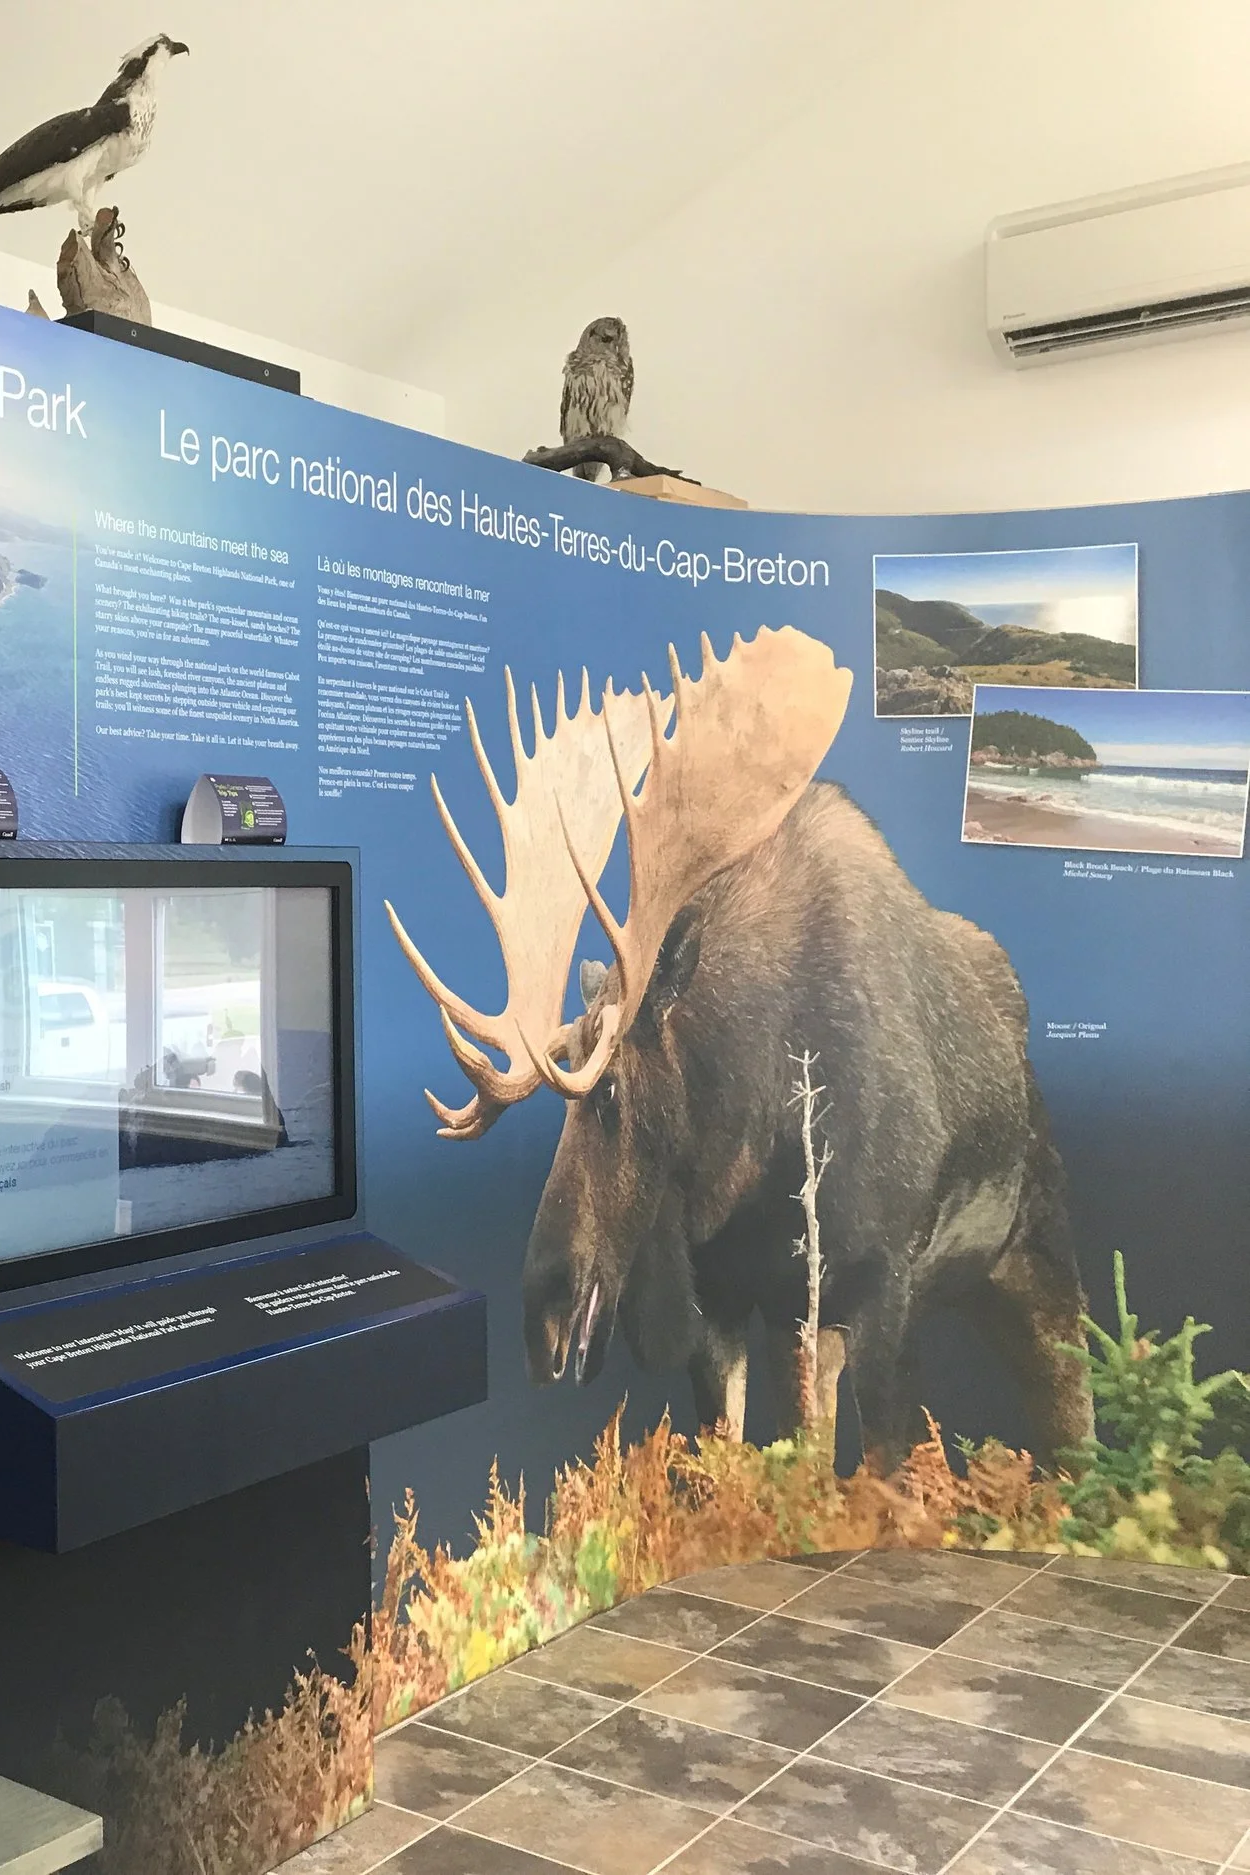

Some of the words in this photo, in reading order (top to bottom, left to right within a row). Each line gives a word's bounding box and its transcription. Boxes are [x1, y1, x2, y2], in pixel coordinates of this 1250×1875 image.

[160, 409, 200, 465] Le
[211, 434, 280, 485] parc
[290, 456, 397, 513] national
[406, 478, 452, 526] des
[461, 489, 831, 588] Hautes-Terres-du-Cap-Breton
[94, 511, 135, 535] Where
[136, 519, 158, 540] the
[159, 527, 219, 551] mountains
[220, 539, 249, 557] meet
[250, 540, 268, 561] the
[270, 548, 289, 565] sea
[346, 561, 361, 579] les
[362, 567, 413, 589] montagnes
[414, 577, 463, 597] rencontrent
[474, 588, 490, 602] mer
